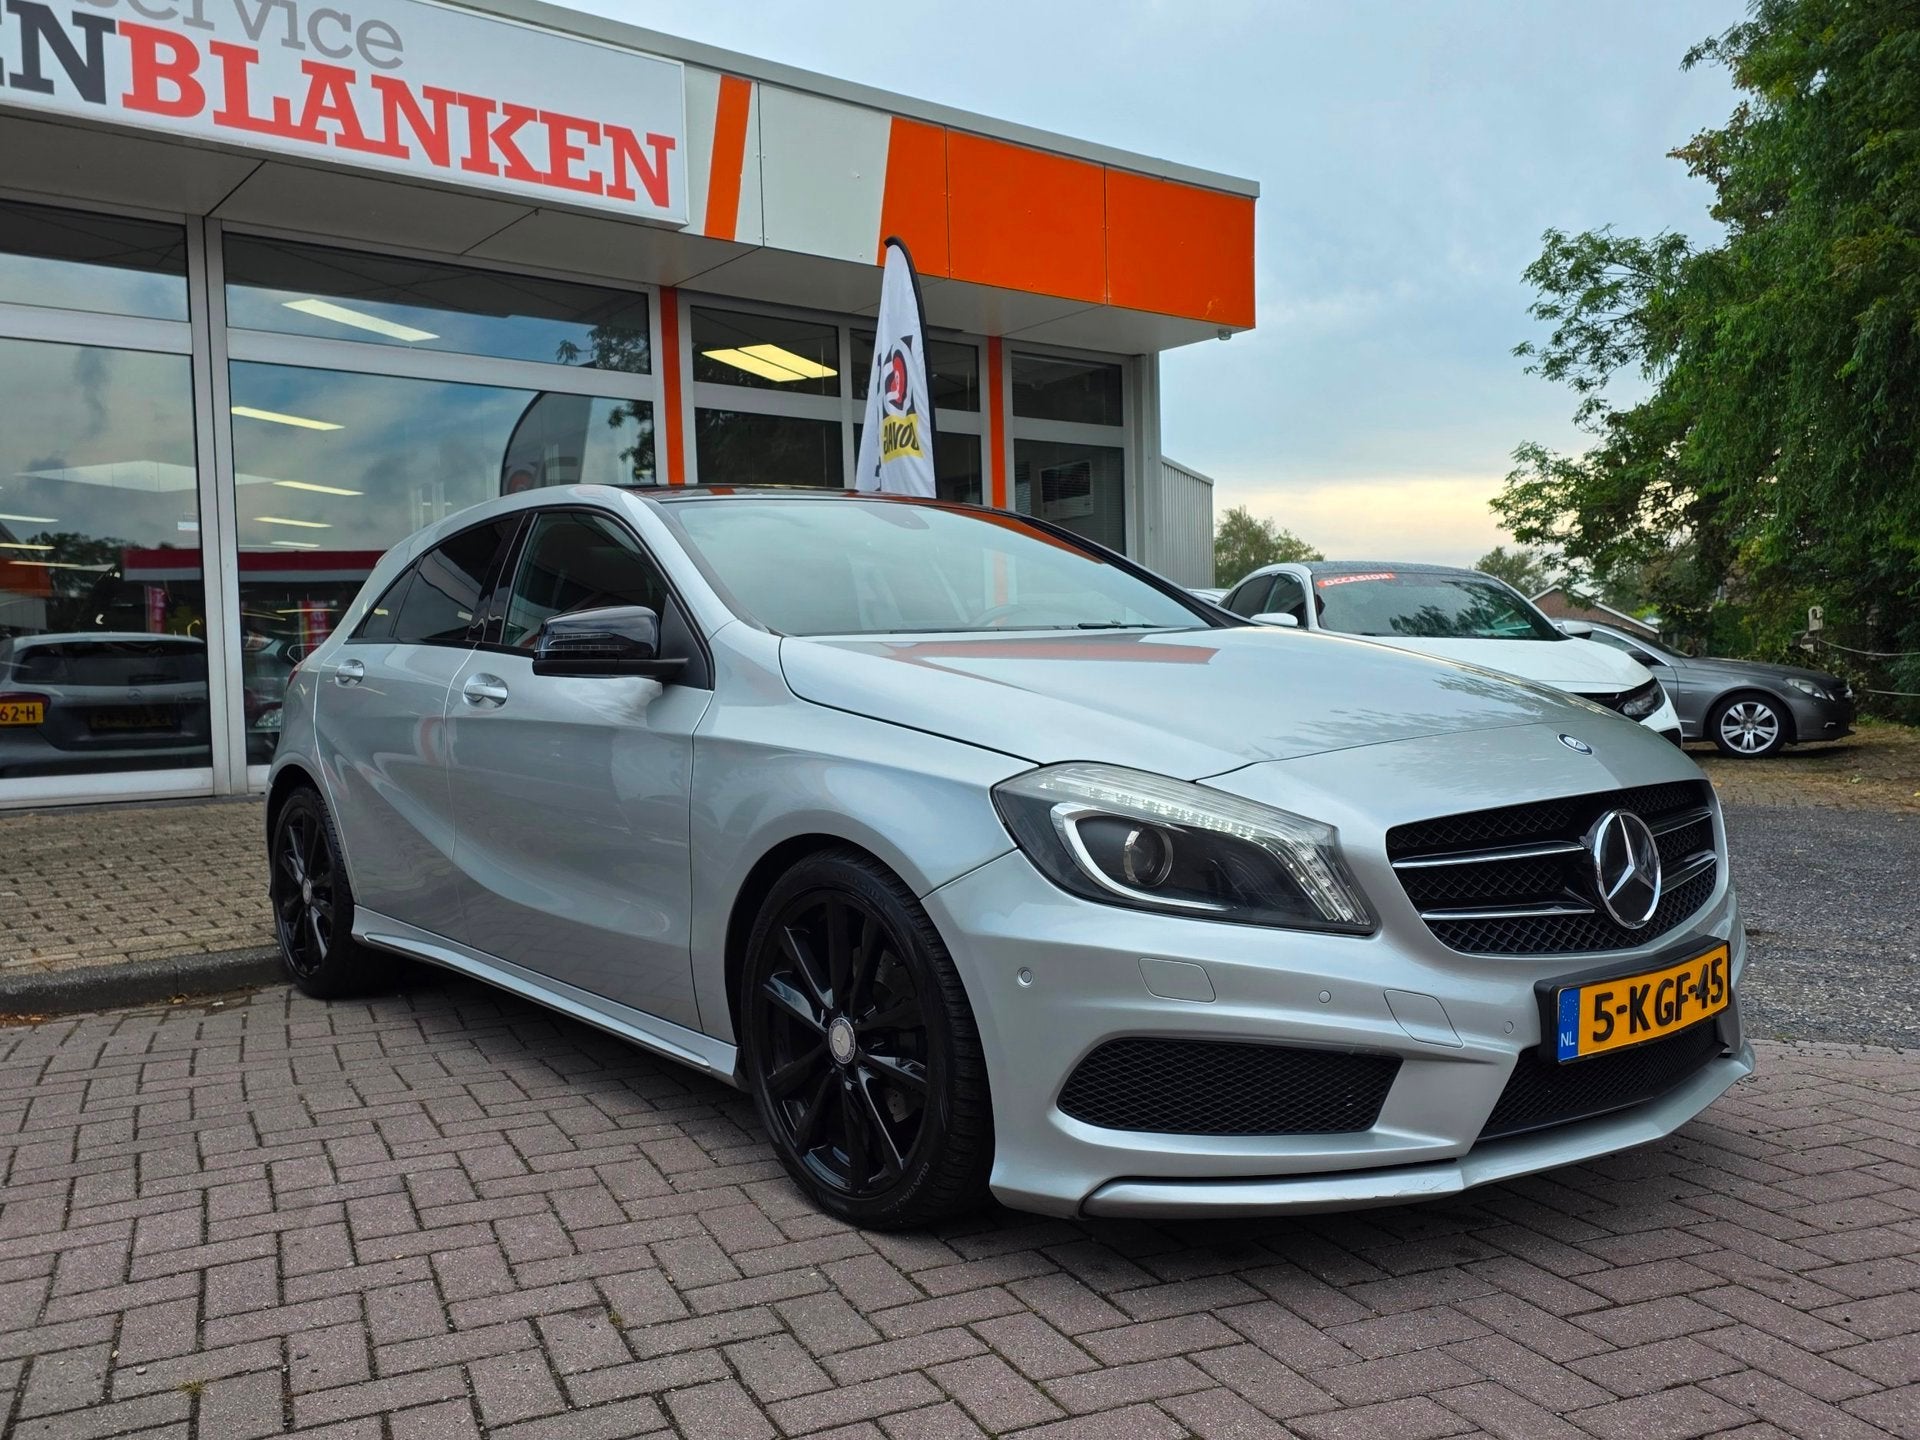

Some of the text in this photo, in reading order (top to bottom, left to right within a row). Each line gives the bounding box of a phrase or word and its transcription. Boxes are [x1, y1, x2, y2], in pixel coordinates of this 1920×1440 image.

[1324, 572, 1390, 586] OCCASION
[1592, 957, 1724, 1042] 5-KGF-45
[1560, 1033, 1576, 1047] NL
